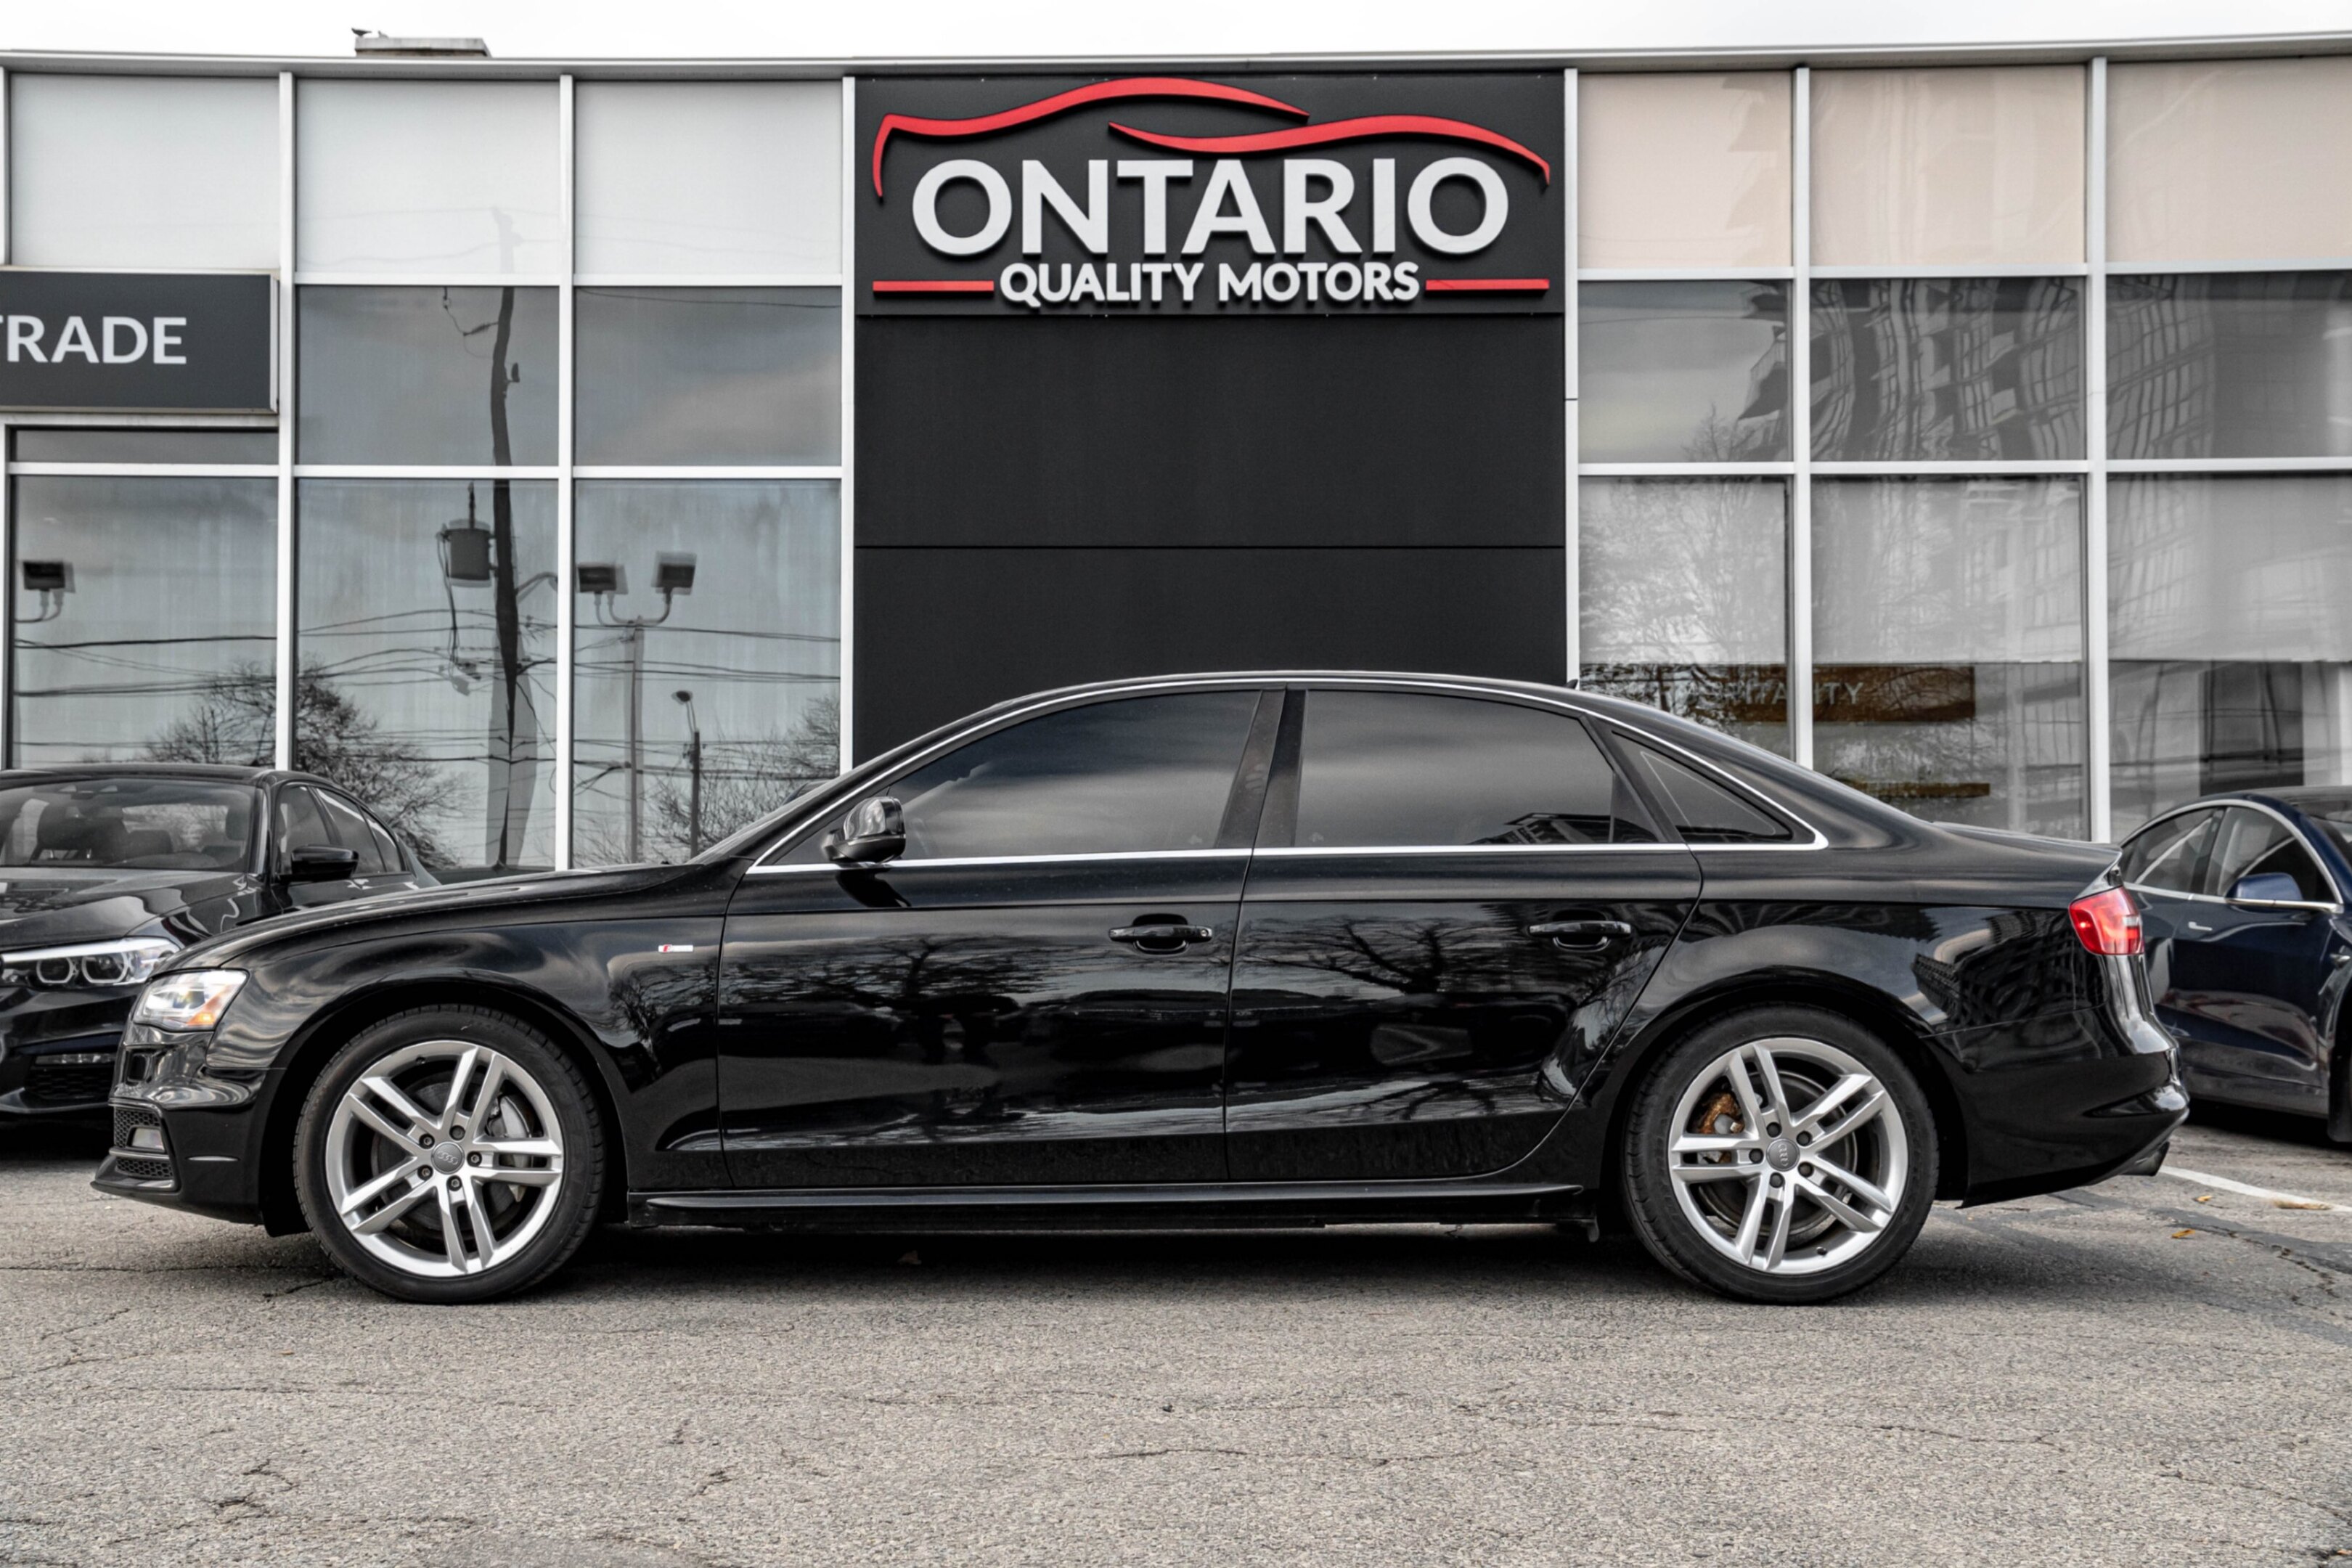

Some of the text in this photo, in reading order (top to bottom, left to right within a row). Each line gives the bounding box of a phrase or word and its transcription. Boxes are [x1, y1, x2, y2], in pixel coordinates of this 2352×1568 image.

[912, 157, 1509, 256] ONTARIO
[999, 261, 1420, 308] QUALITY MOTORS
[0, 314, 187, 364] RADE
